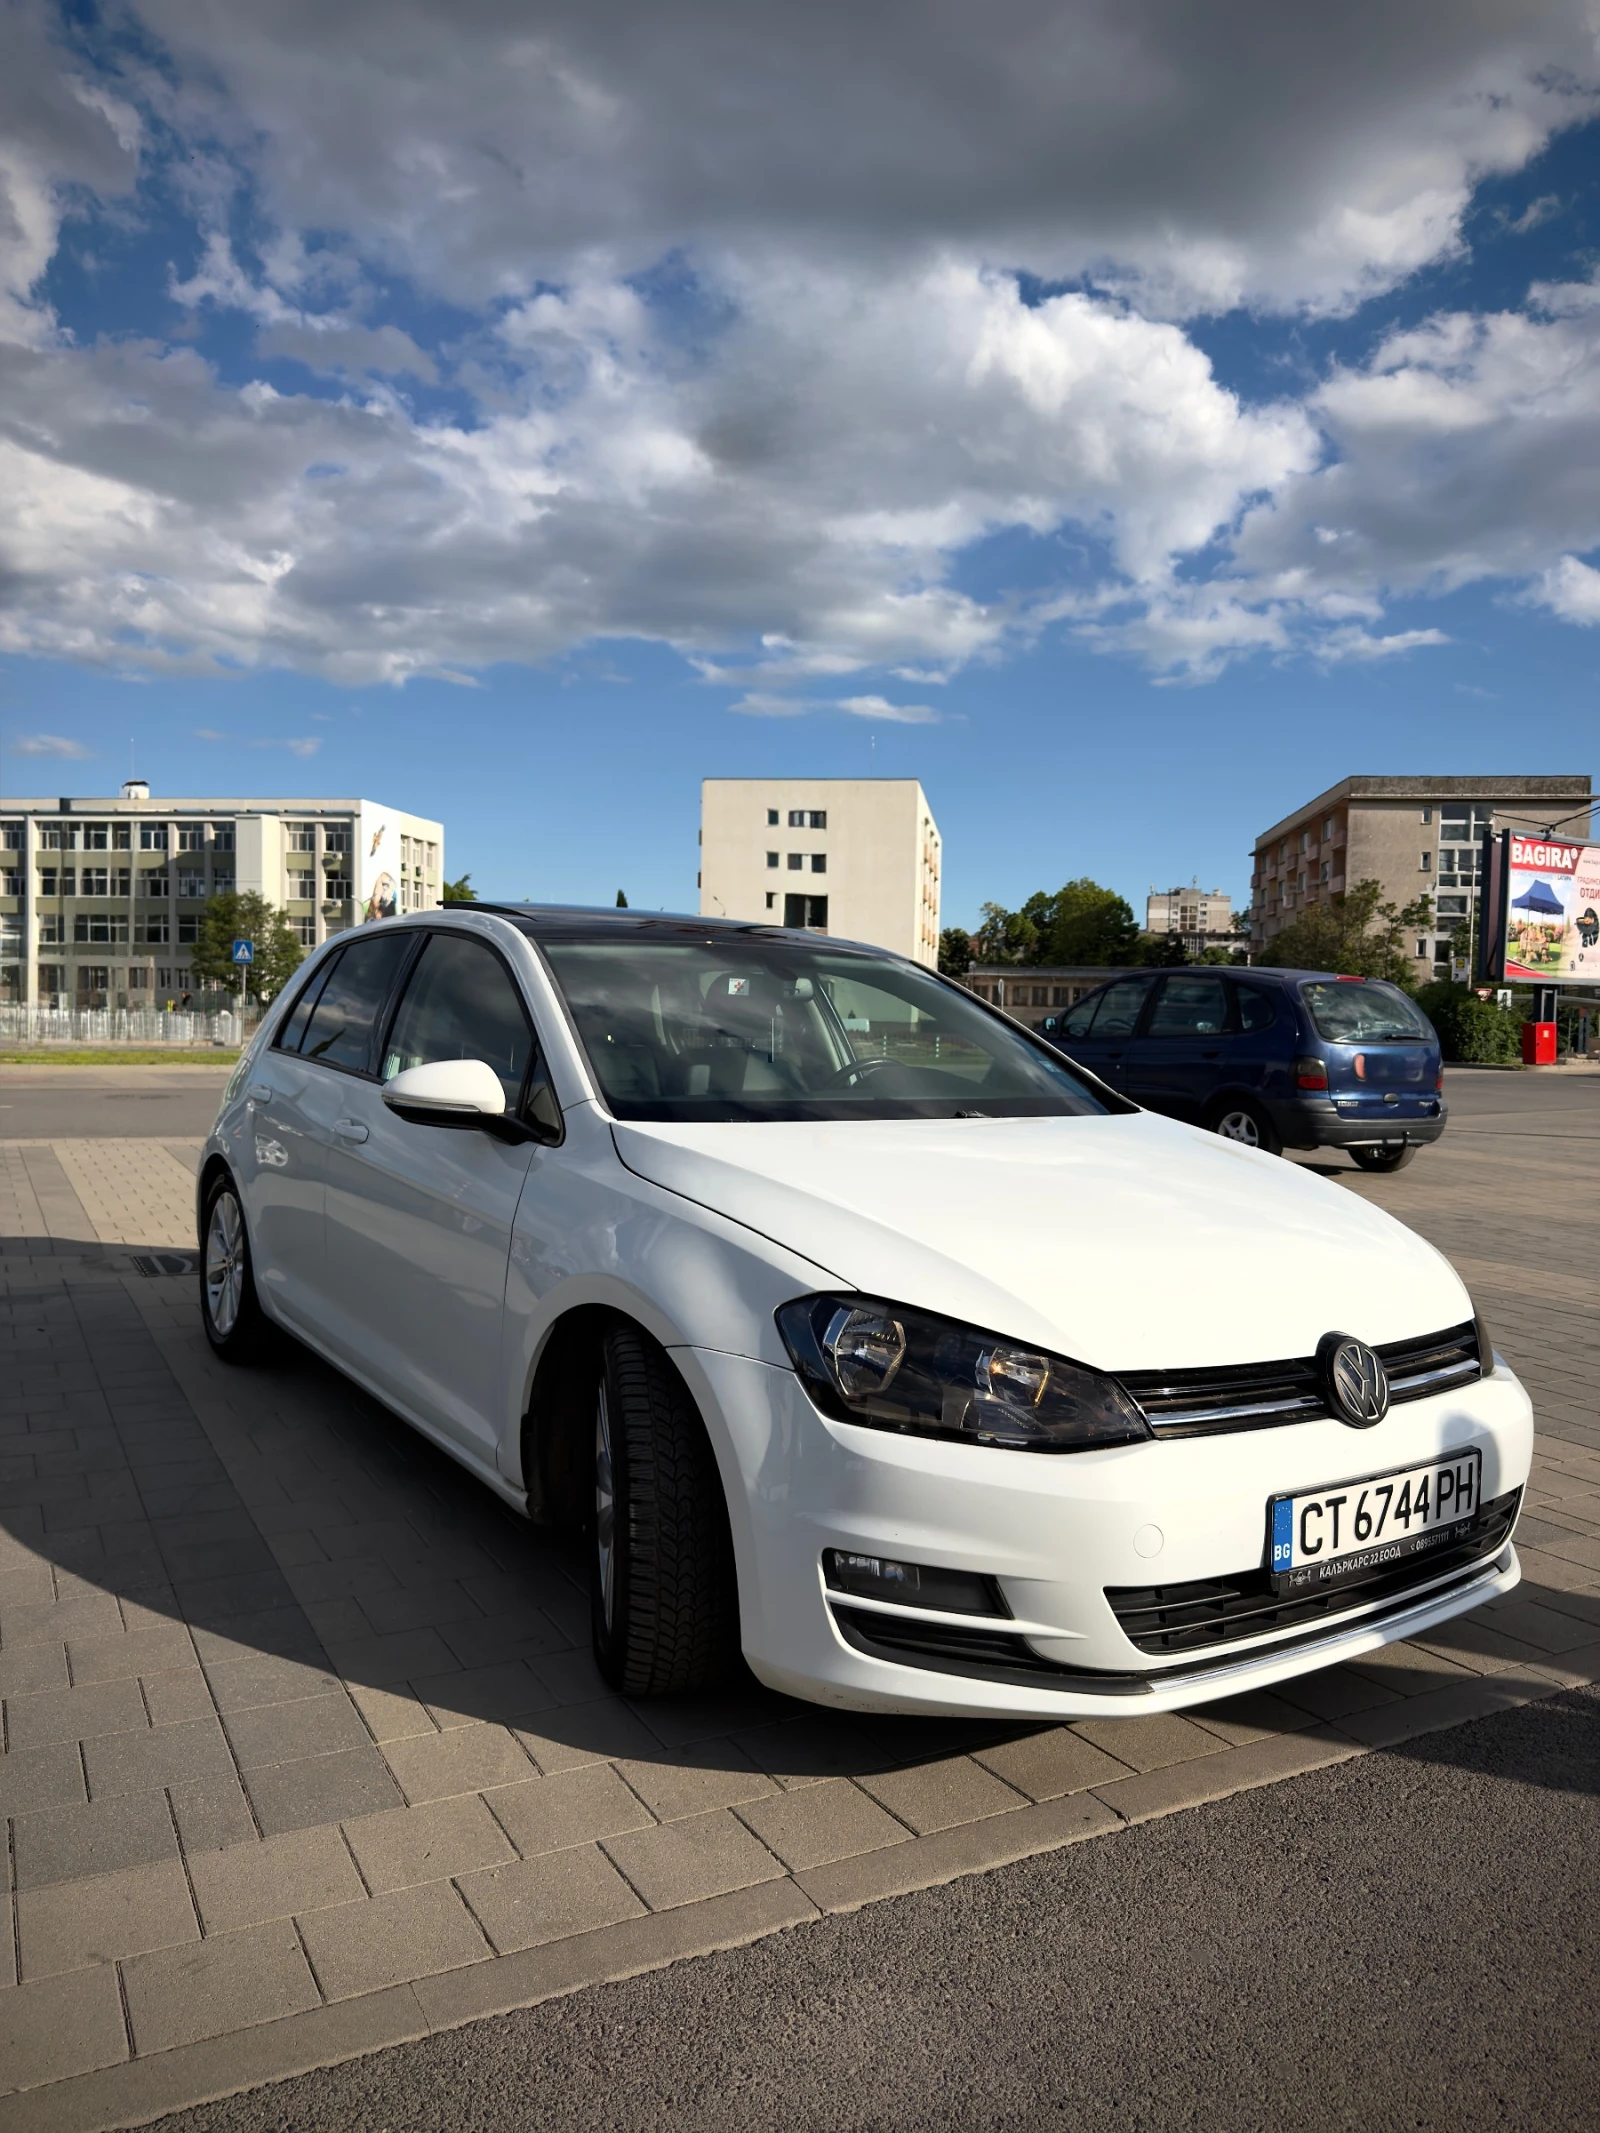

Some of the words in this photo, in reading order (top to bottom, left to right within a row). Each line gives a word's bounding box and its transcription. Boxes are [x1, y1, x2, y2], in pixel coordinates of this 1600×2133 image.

[1512, 843, 1573, 869] BAGIRA
[1300, 1495, 1347, 1556] CT
[1354, 1475, 1430, 1541] 6744
[1435, 1462, 1474, 1520] PH
[1274, 1543, 1291, 1561] BG
[1369, 1552, 1379, 1565] 22
[1379, 1545, 1401, 1562] ЕООД
